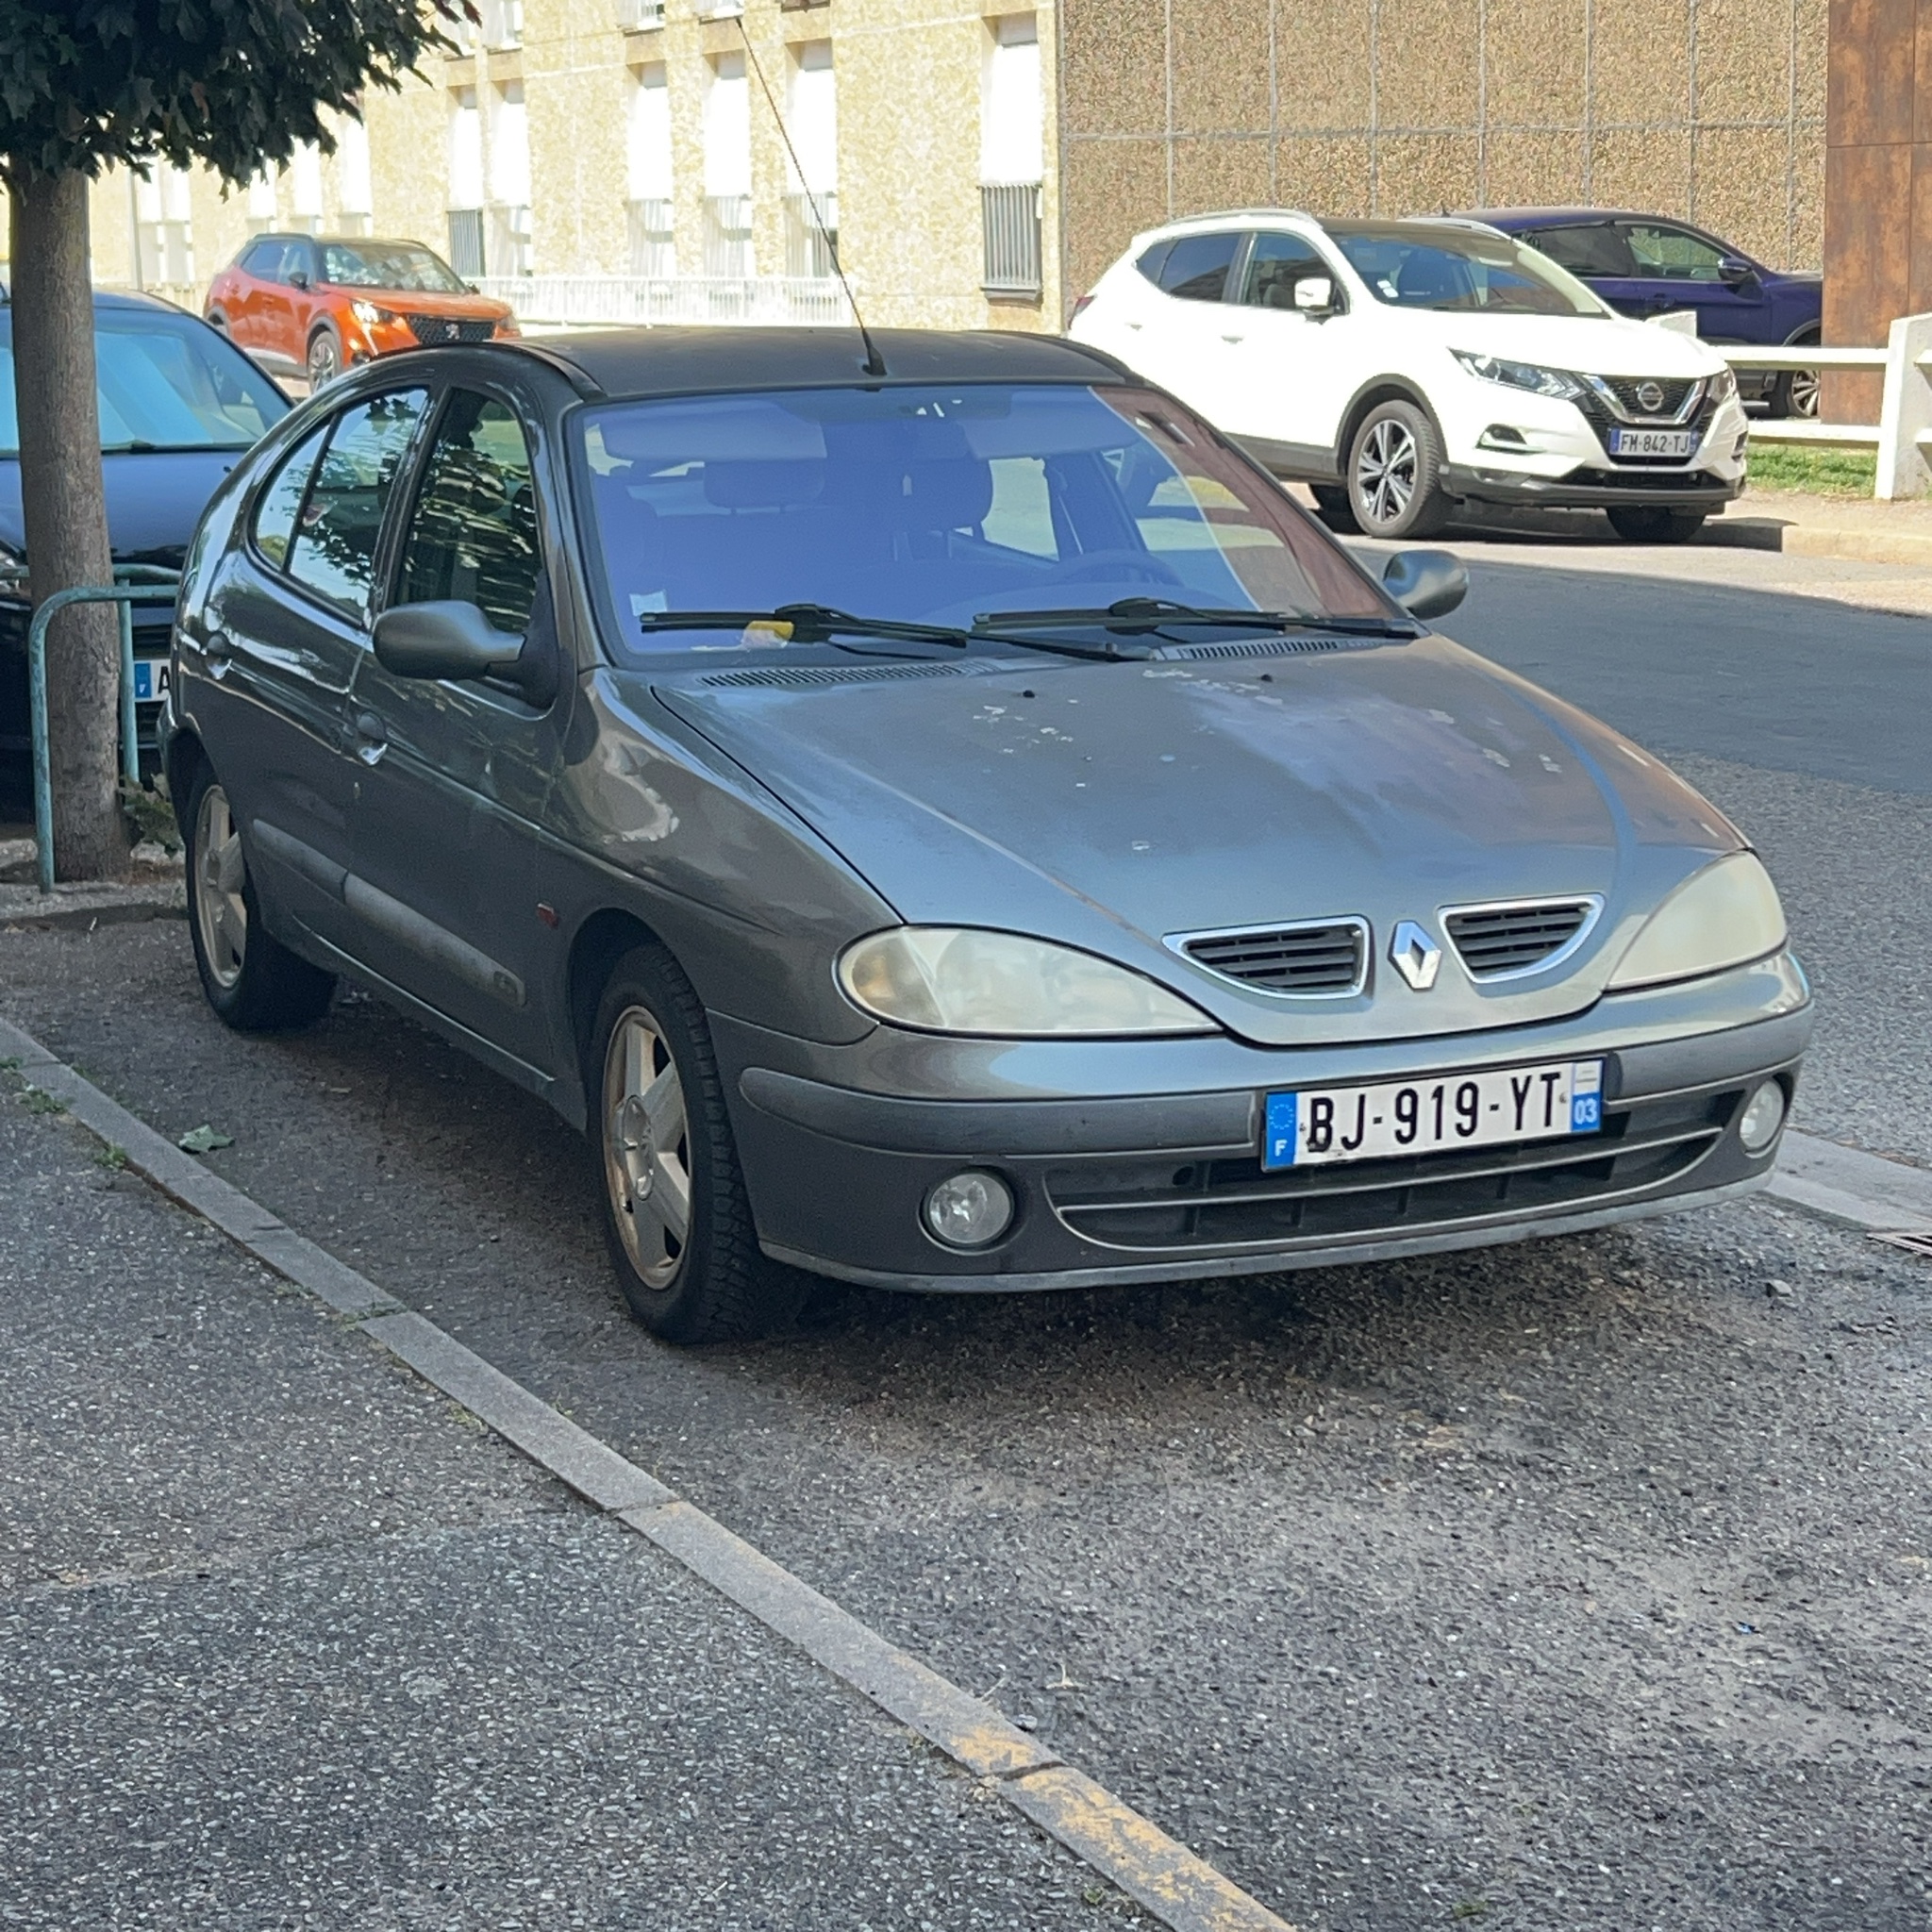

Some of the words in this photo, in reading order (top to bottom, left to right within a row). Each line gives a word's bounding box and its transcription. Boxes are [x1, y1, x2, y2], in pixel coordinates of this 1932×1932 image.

[1621, 434, 1689, 453] FM-842-TJ
[1275, 1139, 1288, 1157] F
[1306, 1072, 1561, 1153] BJ-919-YT
[1574, 1098, 1597, 1124] 03
